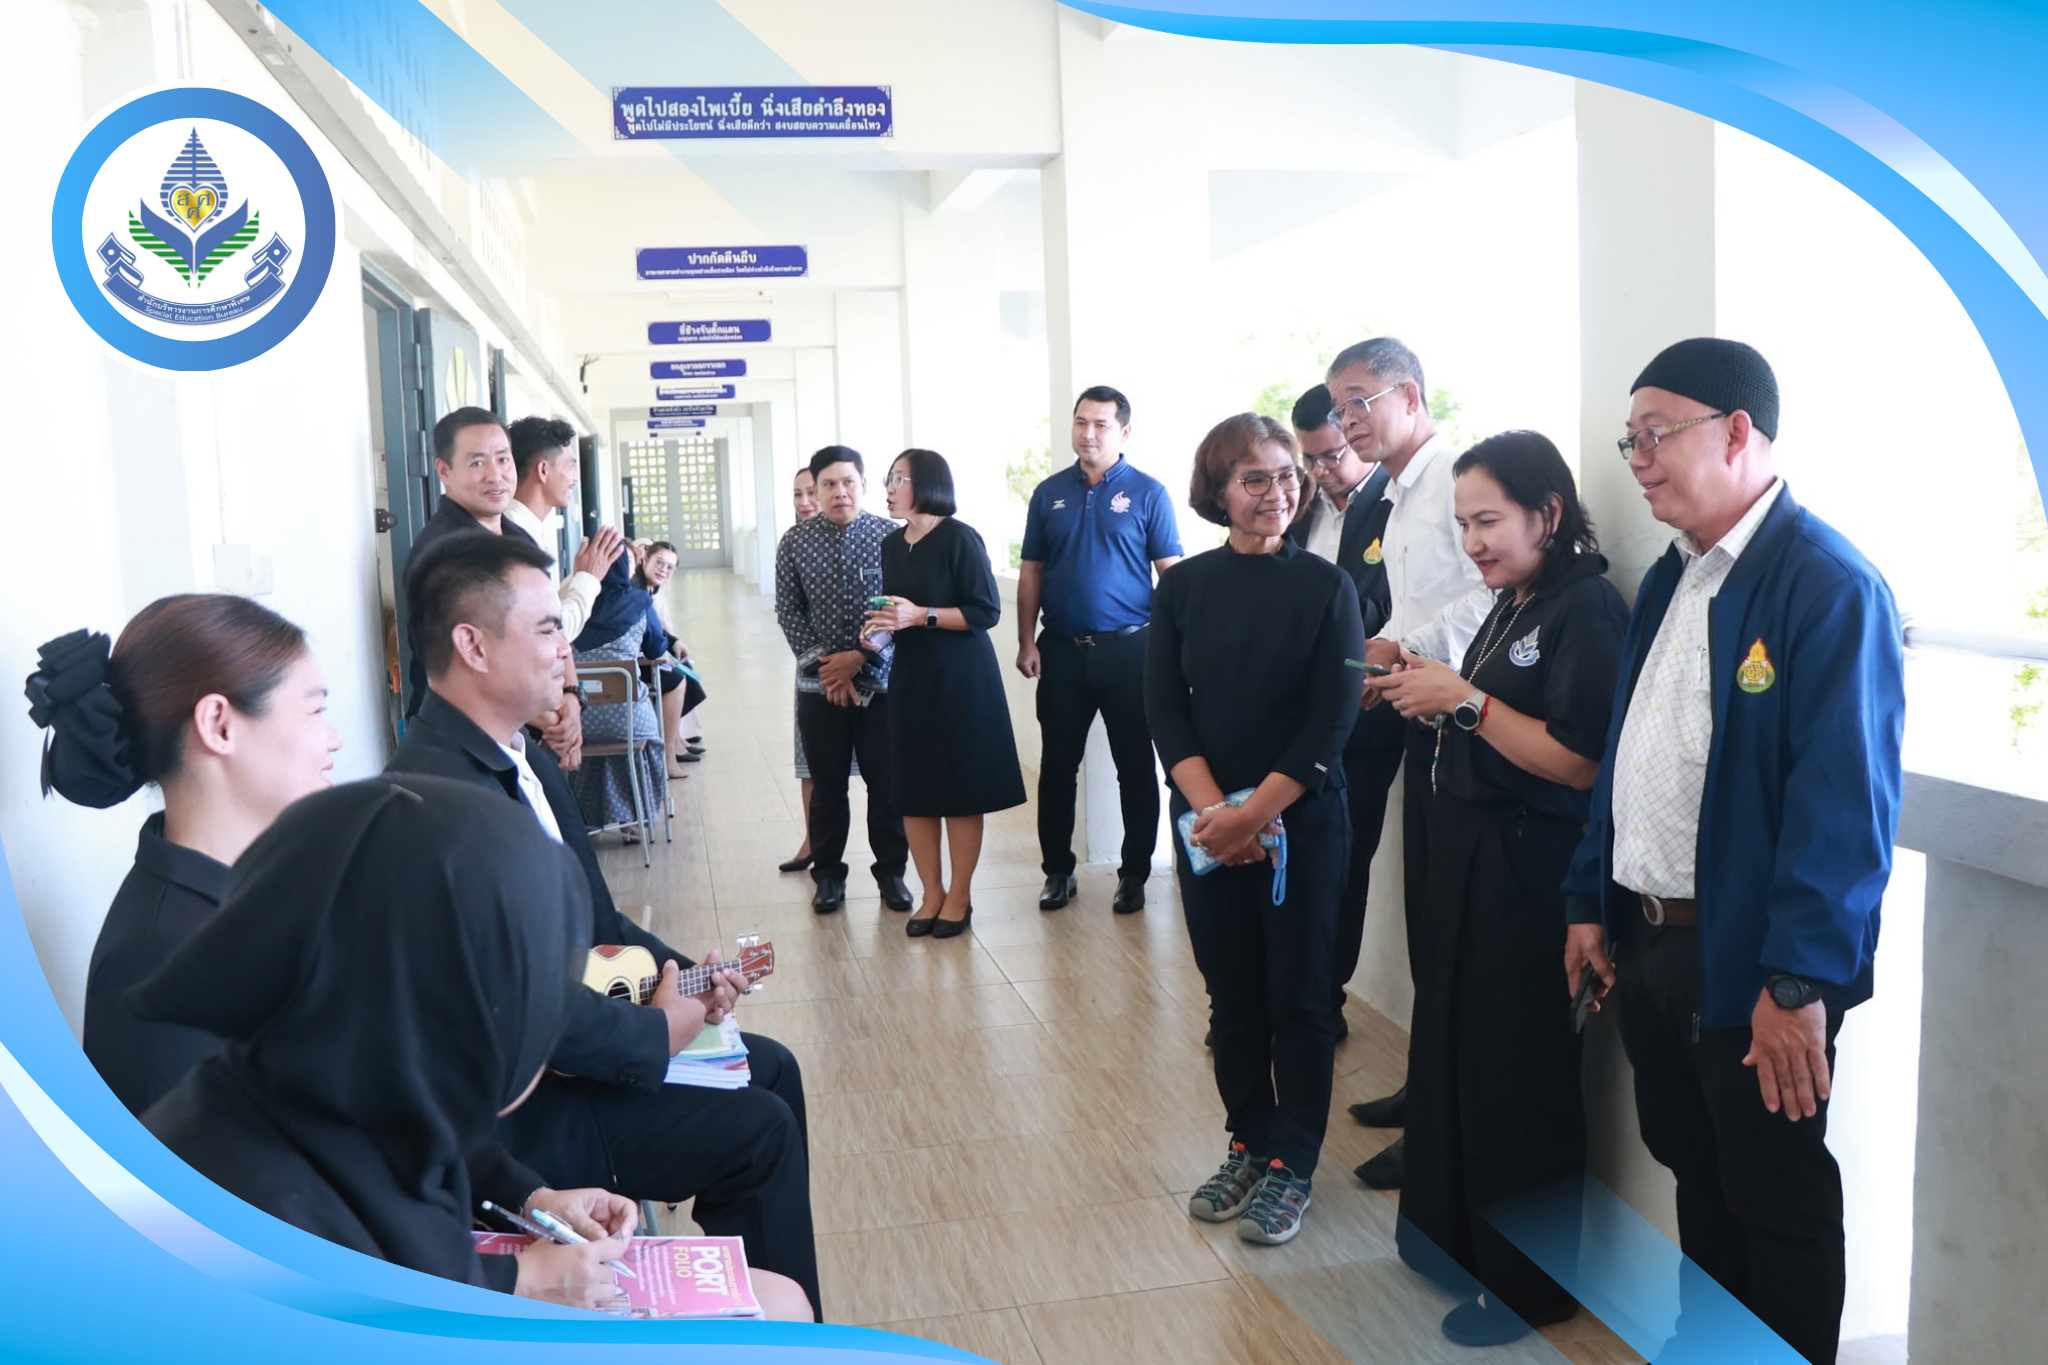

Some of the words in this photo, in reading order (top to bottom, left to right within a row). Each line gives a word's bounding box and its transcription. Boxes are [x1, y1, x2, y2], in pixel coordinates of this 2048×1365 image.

[621, 92, 752, 122] พูดไปสองไพเบี้ย
[761, 93, 886, 117] นิ่งเสียตำลึงทอง
[673, 1246, 693, 1278] FOLIO
[690, 1246, 729, 1295] PORT
